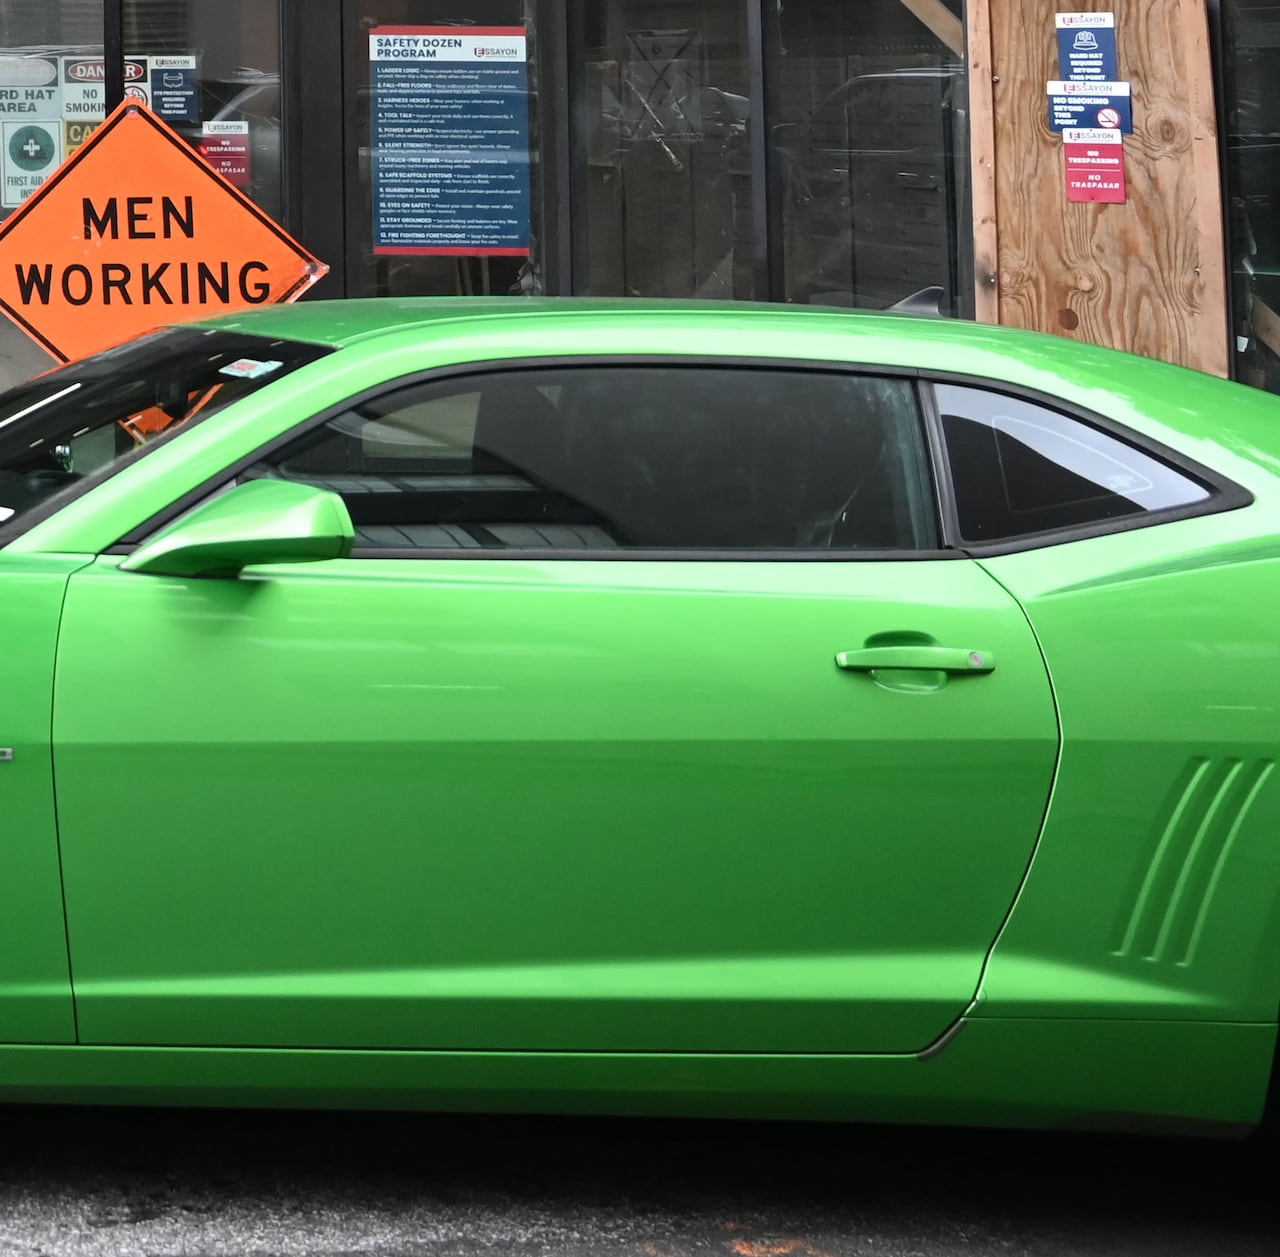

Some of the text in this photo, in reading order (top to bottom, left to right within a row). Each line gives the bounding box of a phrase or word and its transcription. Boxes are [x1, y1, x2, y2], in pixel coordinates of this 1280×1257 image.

[377, 38, 462, 48] SAFETY DOZEN
[377, 49, 437, 58] PROGRAM
[474, 47, 518, 58] ESSAYON
[76, 65, 136, 77] DANR
[82, 89, 98, 99] NO
[1063, 84, 1113, 94] ESSAYON
[25, 90, 55, 100] HAT
[1053, 97, 1110, 105] NO SMOKING
[65, 103, 106, 113] SMOKIN
[1069, 132, 1114, 141] ESSAYON
[7, 176, 44, 186] FIRST AID
[1070, 181, 1120, 189] TRASPASAR
[82, 195, 195, 241] MEN
[14, 260, 271, 306] WORKING
